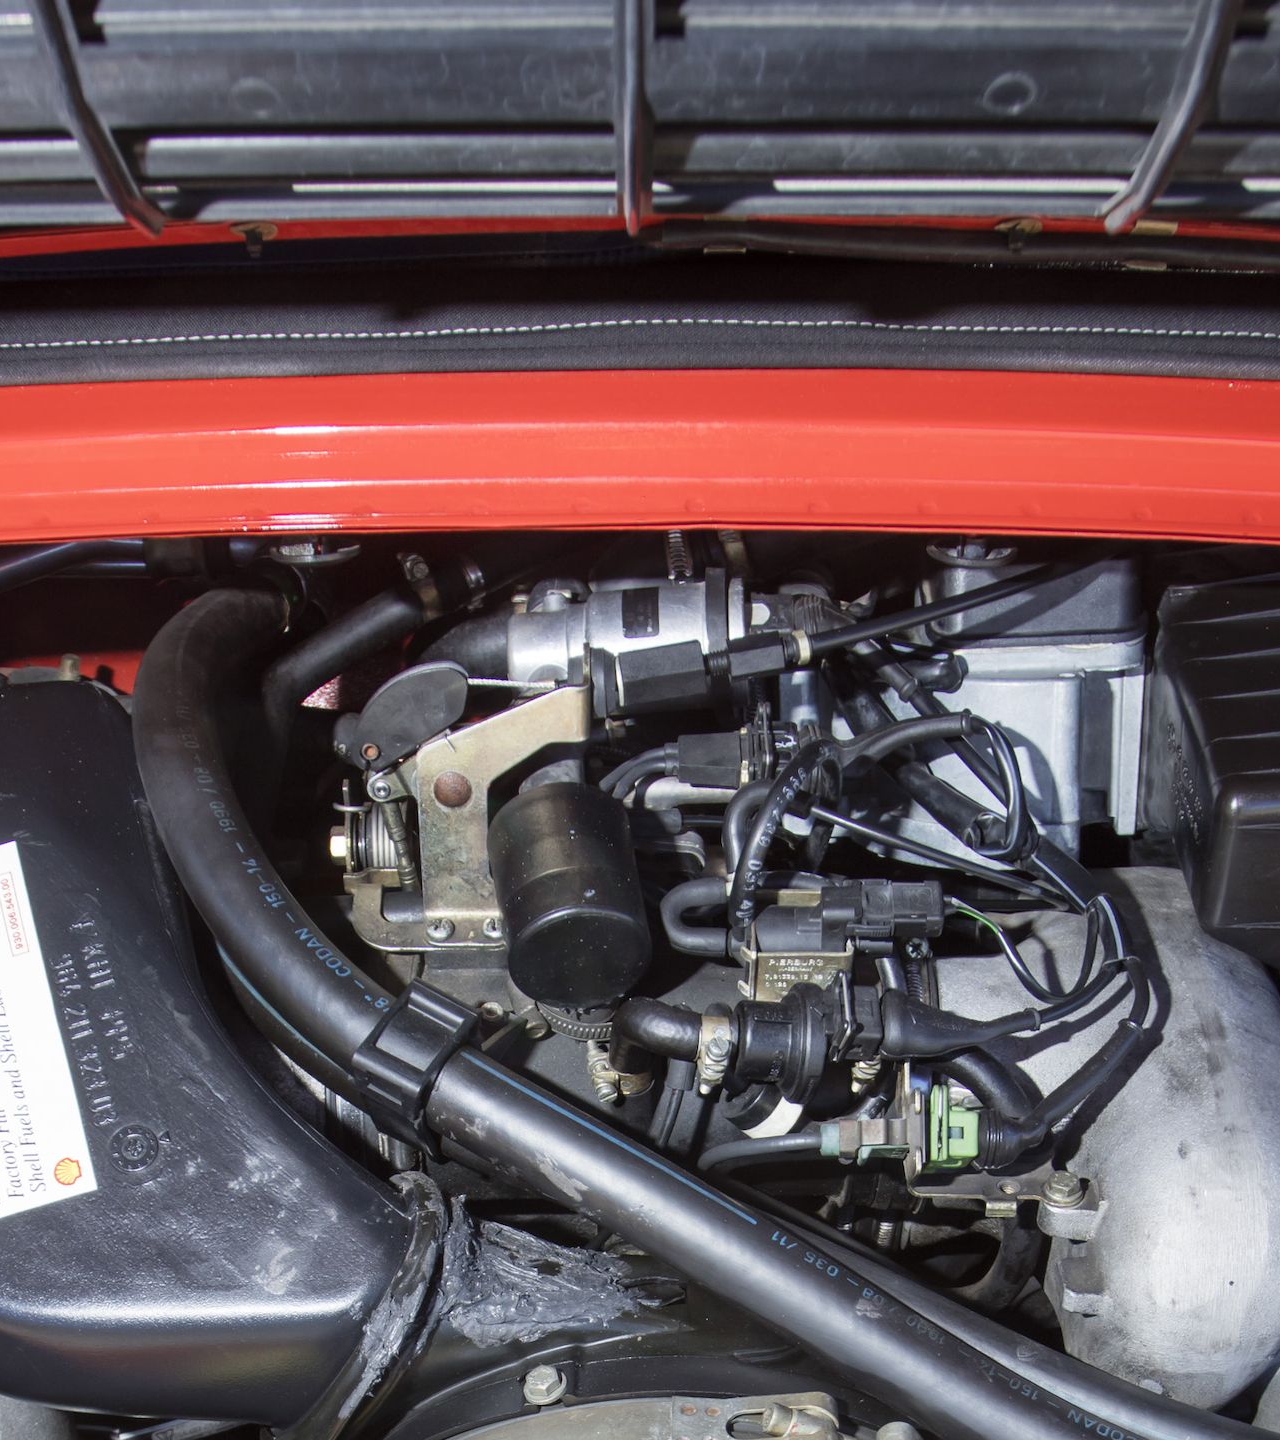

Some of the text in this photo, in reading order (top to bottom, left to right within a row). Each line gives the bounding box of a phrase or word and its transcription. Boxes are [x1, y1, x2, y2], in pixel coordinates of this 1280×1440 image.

[294, 926, 351, 977] CODAN
[4, 1069, 26, 1099] and
[13, 1104, 36, 1146] Fuels
[1, 1140, 25, 1198] Factory
[22, 1153, 47, 1193] Shell
